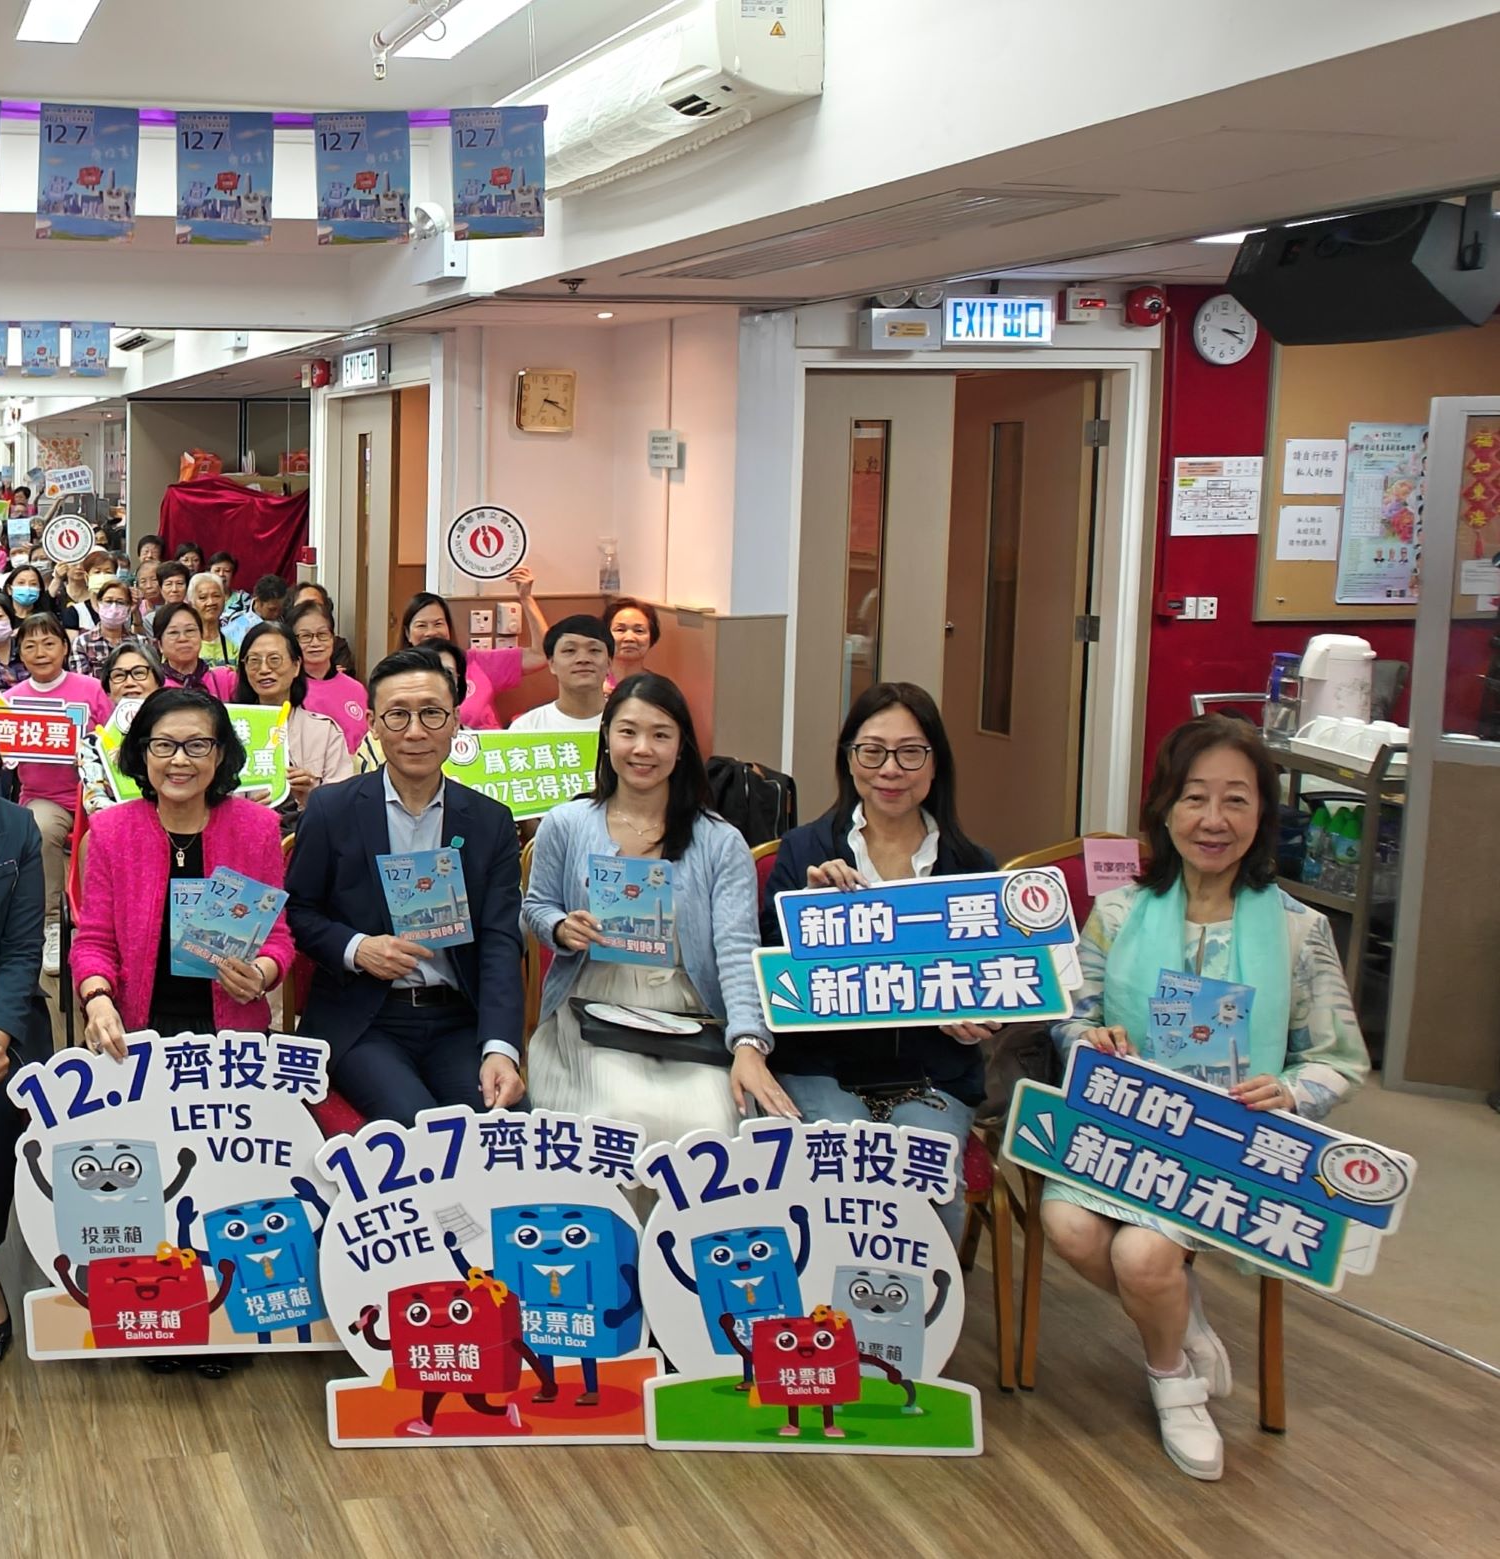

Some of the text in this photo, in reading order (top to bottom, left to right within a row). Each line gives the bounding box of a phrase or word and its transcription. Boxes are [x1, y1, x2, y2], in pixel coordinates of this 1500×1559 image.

[952, 302, 998, 337] EXIT
[1003, 303, 1043, 338] 出口
[430, 922, 467, 940] 到時見
[800, 893, 999, 947] 新的一票
[626, 940, 668, 955] 到時見
[17, 1039, 323, 1130] 12.7 齊投票
[171, 1103, 252, 1132] LET'S
[1083, 1064, 1314, 1183] 新的一票
[207, 1137, 293, 1167] VOTE
[326, 1116, 639, 1203] 12.7 齊投票
[647, 1126, 951, 1212] 12.7 齊投票
[337, 1198, 419, 1246] LET'S
[824, 1197, 898, 1228] LET'S
[82, 1225, 142, 1245] 投票箱
[347, 1226, 435, 1272] VOTE
[89, 1245, 136, 1254] Ballot Box
[849, 1232, 929, 1268] VOTE
[246, 1287, 311, 1317] 投票箱
[116, 1310, 181, 1330] 投票箱
[257, 1308, 307, 1325] Ballot Box
[521, 1309, 595, 1337] 投票箱
[125, 1329, 175, 1340] Ballot Box
[530, 1333, 587, 1348] Ballot Box
[408, 1344, 481, 1370] 投票箱
[419, 1370, 473, 1382] Ballot Box
[779, 1367, 836, 1387] 投票箱
[787, 1386, 831, 1395] Ballot Box
